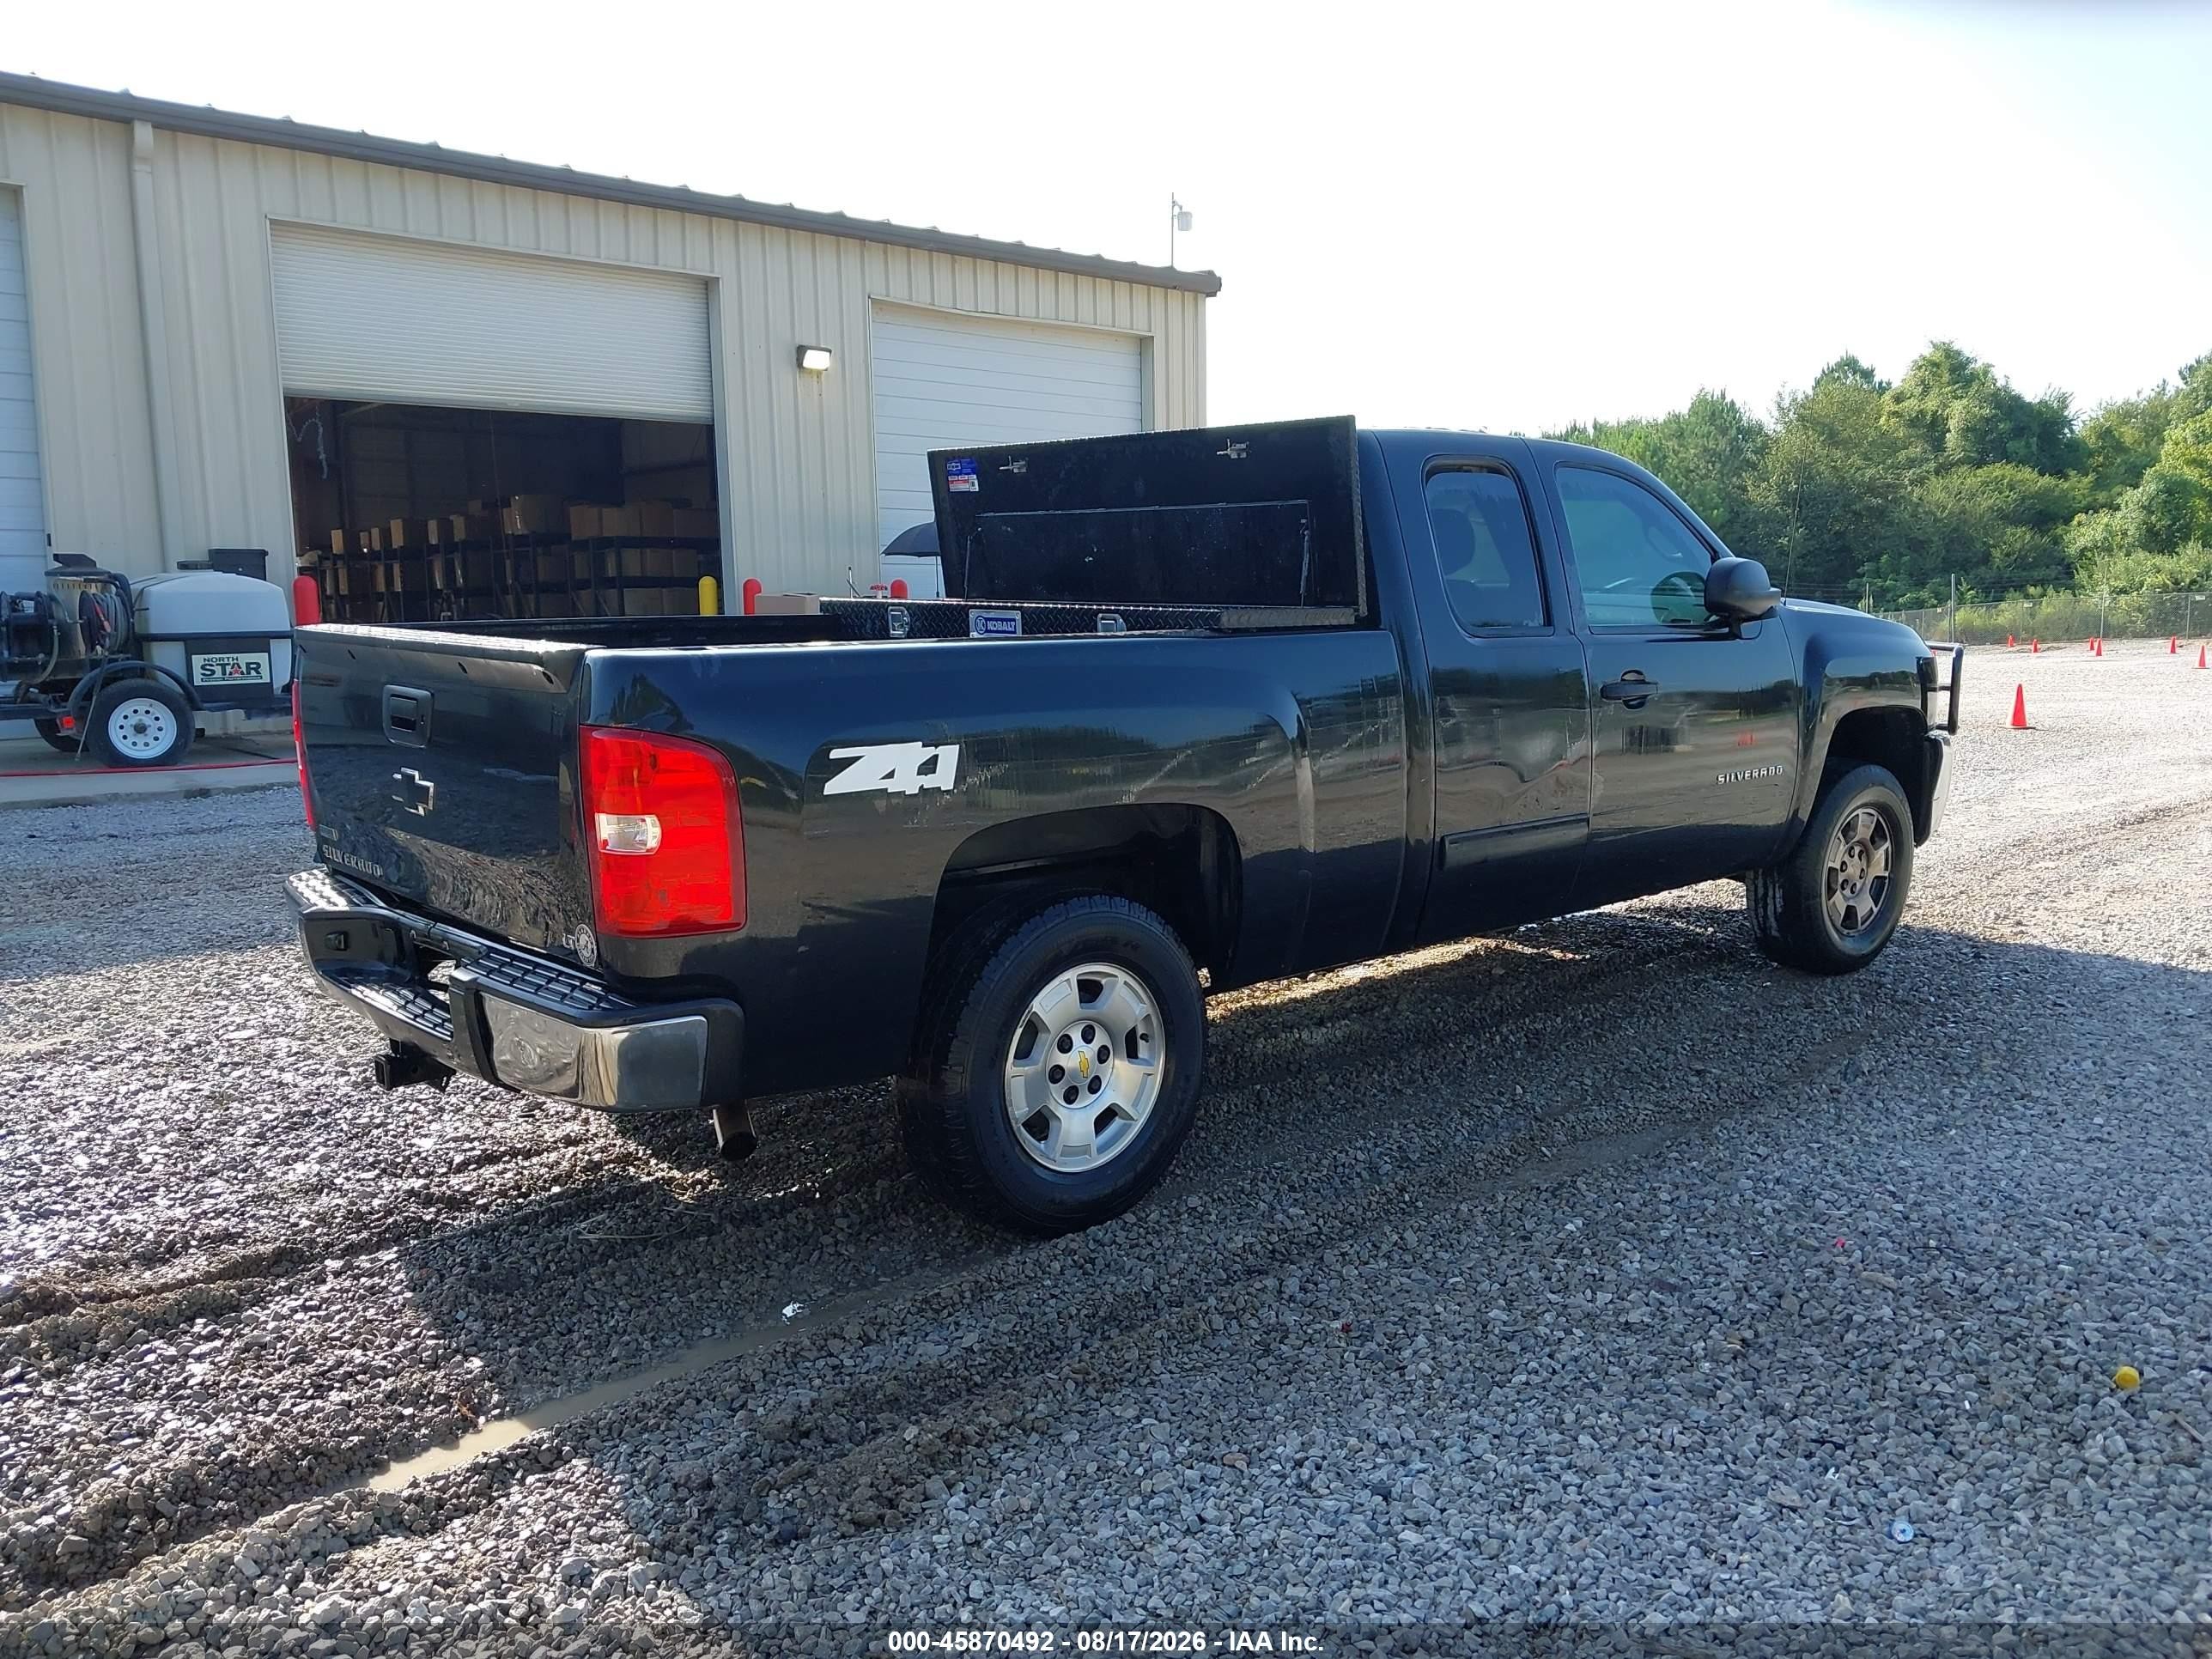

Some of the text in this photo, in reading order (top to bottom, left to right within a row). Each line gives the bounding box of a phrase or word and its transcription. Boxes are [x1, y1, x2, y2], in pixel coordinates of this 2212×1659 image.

[988, 621, 1016, 631] KOBALT
[200, 660, 262, 677] STAR
[1717, 765, 1784, 785] SILVERADO
